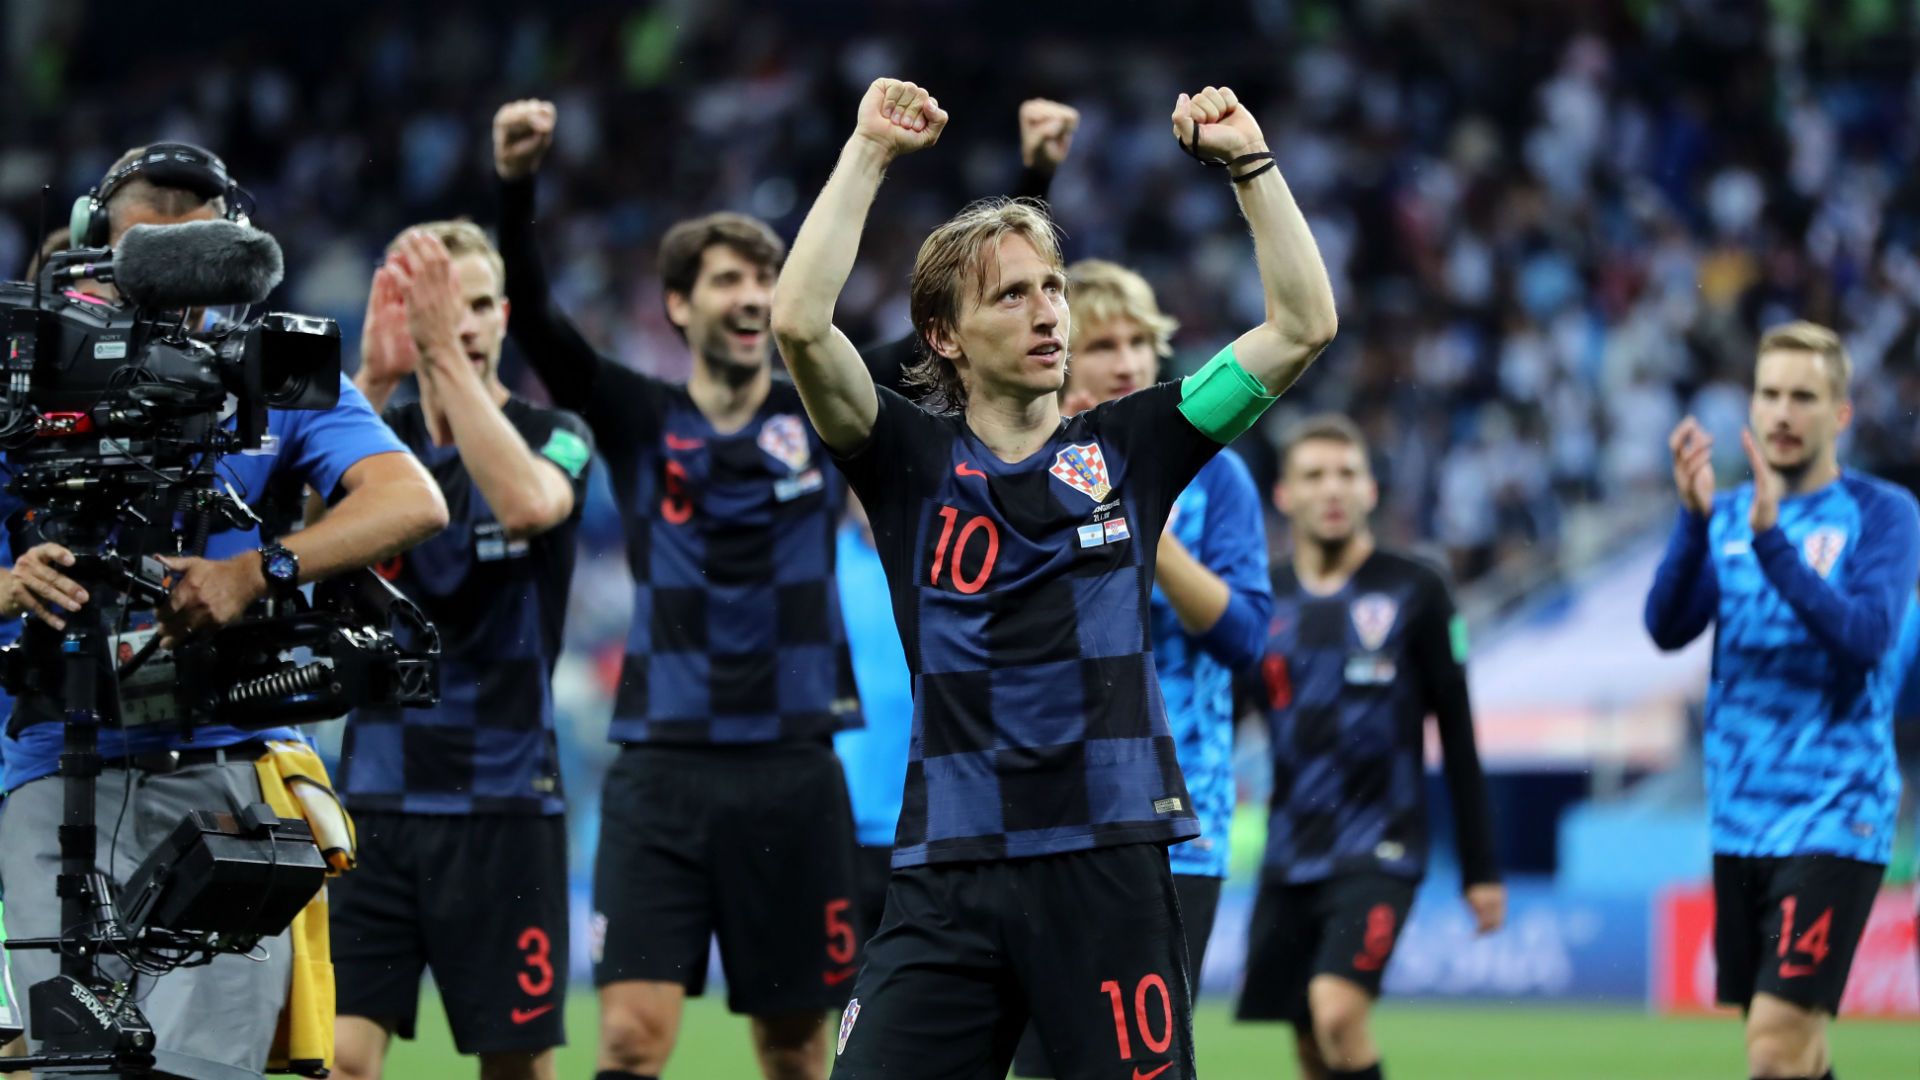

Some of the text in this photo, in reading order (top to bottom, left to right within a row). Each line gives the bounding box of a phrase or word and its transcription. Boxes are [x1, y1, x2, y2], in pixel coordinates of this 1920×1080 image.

[930, 505, 998, 594] 10
[517, 926, 553, 996] 3
[825, 899, 856, 963] 5
[1777, 895, 1833, 964] 14
[1100, 973, 1172, 1060] 10
